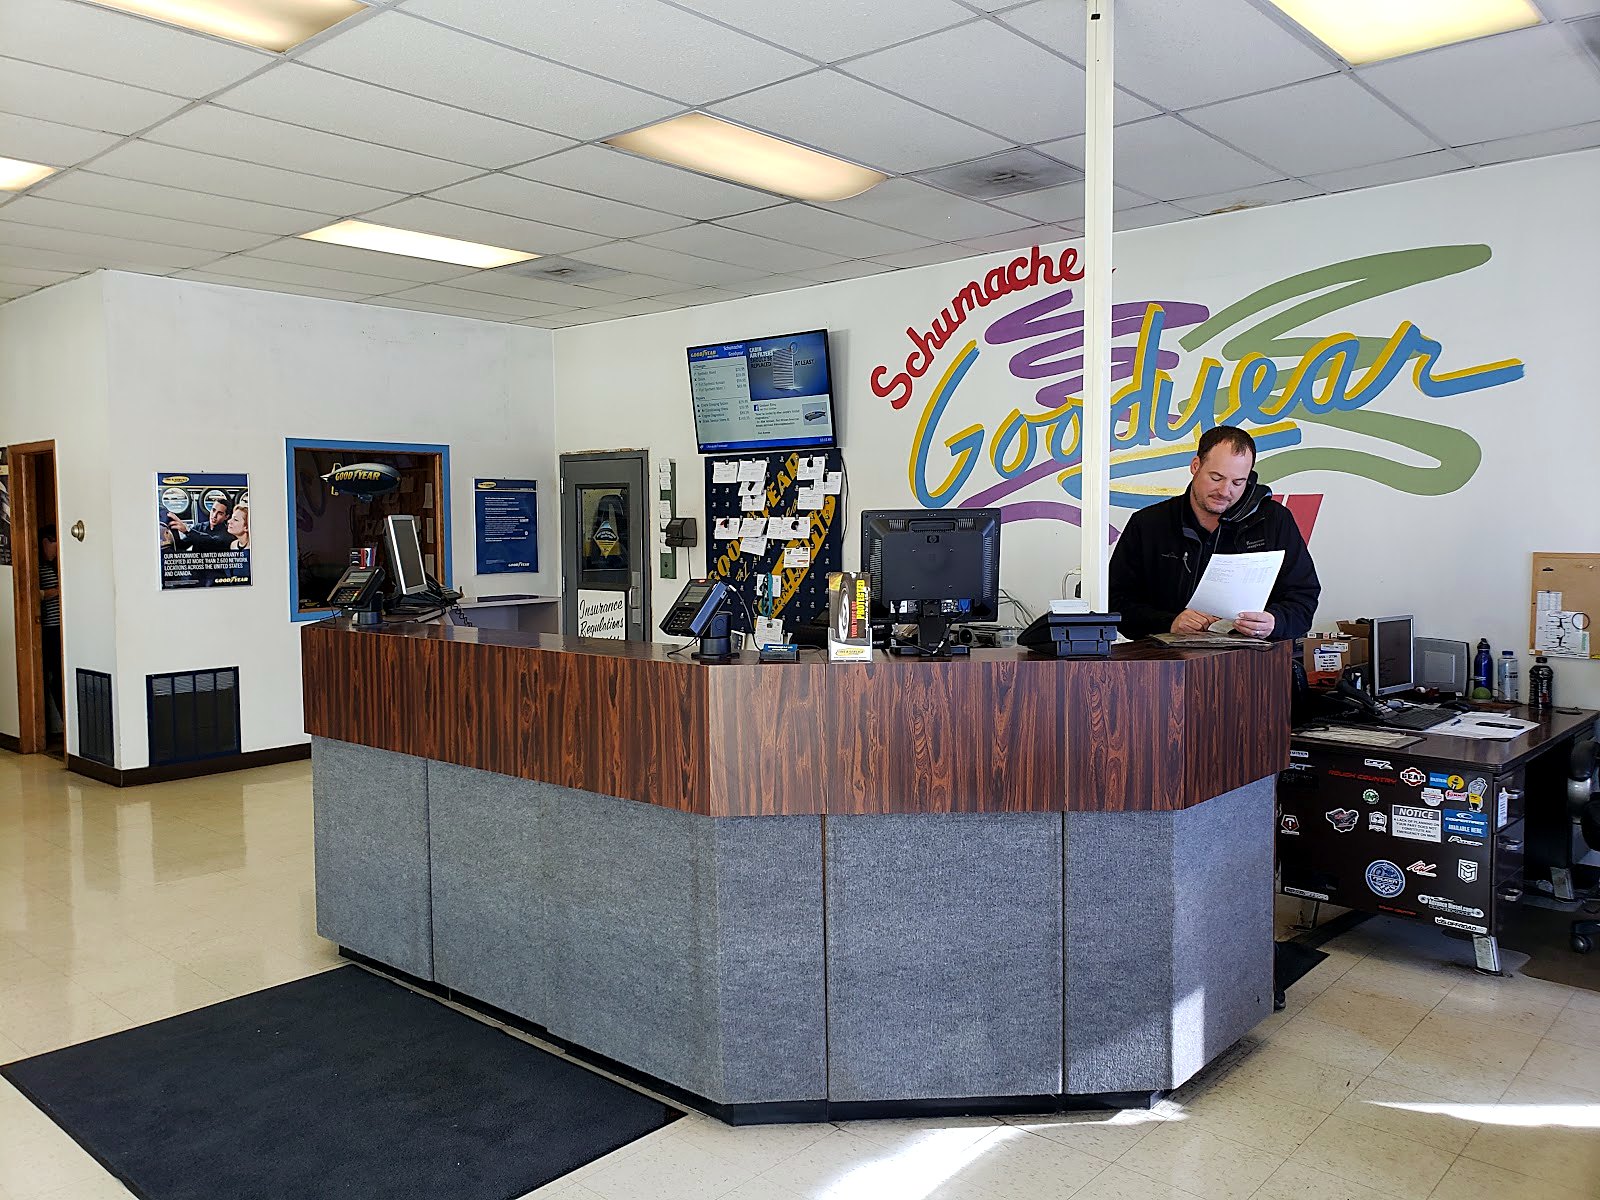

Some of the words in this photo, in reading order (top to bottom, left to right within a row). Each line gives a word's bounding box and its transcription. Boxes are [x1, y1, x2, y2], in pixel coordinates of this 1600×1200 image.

[871, 246, 1085, 410] Schumache
[336, 469, 381, 481] GOODYEAR
[214, 576, 249, 584] GOODYEAR
[856, 579, 865, 620] PROTECTED
[579, 600, 623, 619] Insurance
[579, 617, 624, 637] Regulations
[1401, 773, 1425, 782] GEAR
[1399, 808, 1434, 820] NOTICE
[1447, 824, 1471, 833] AVAILABLE
